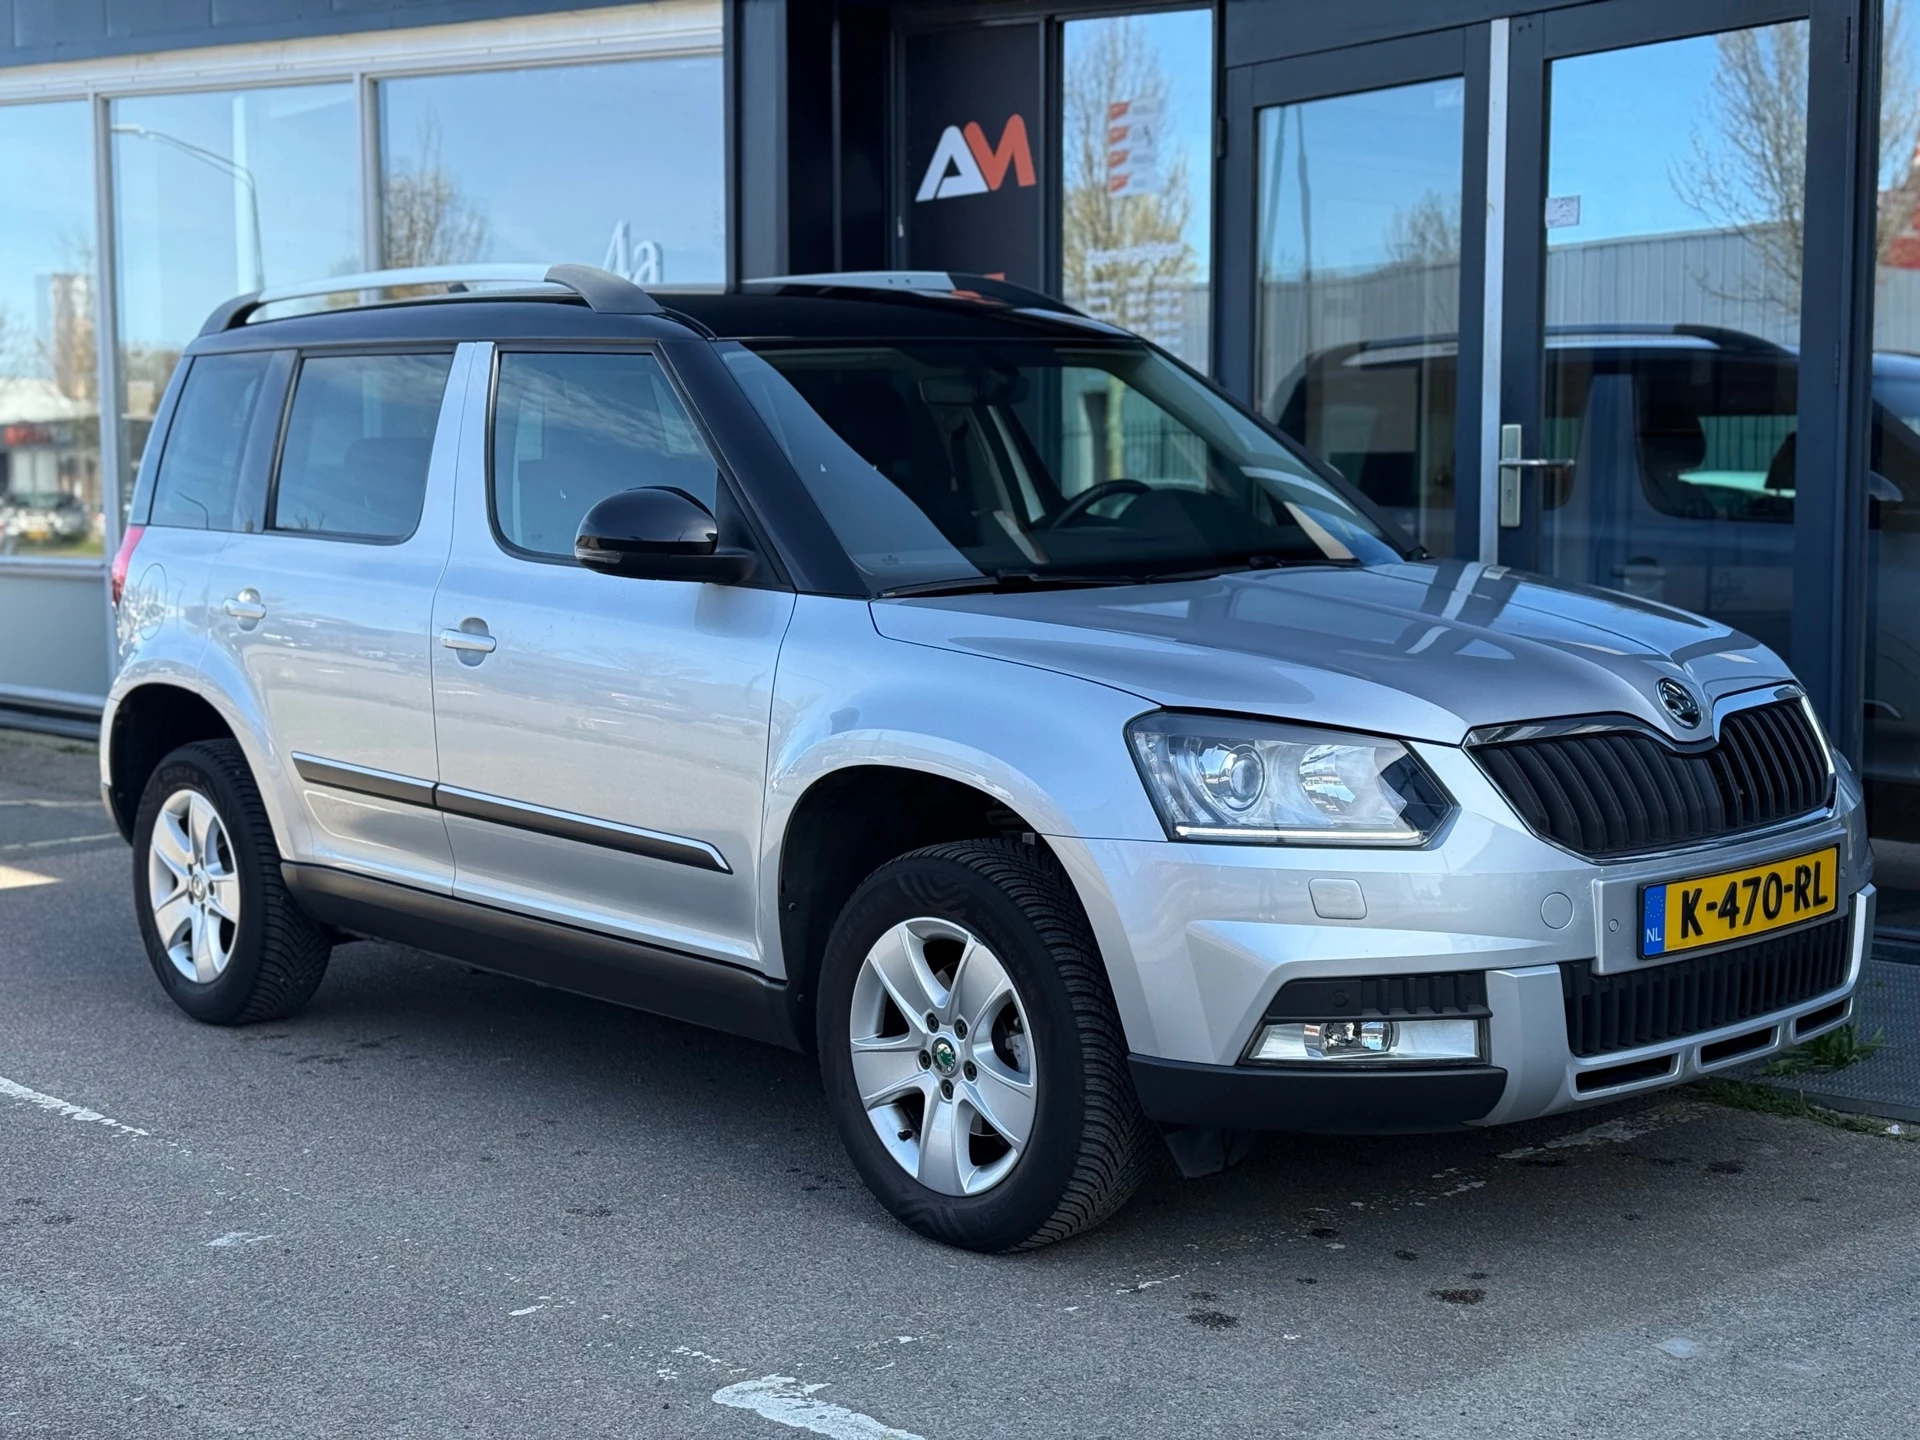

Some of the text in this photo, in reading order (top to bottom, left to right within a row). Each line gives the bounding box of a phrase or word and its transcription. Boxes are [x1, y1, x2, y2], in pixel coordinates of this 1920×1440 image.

[915, 113, 1036, 202] AM
[1646, 927, 1662, 943] NL
[1681, 861, 1828, 939] K-470-RL
